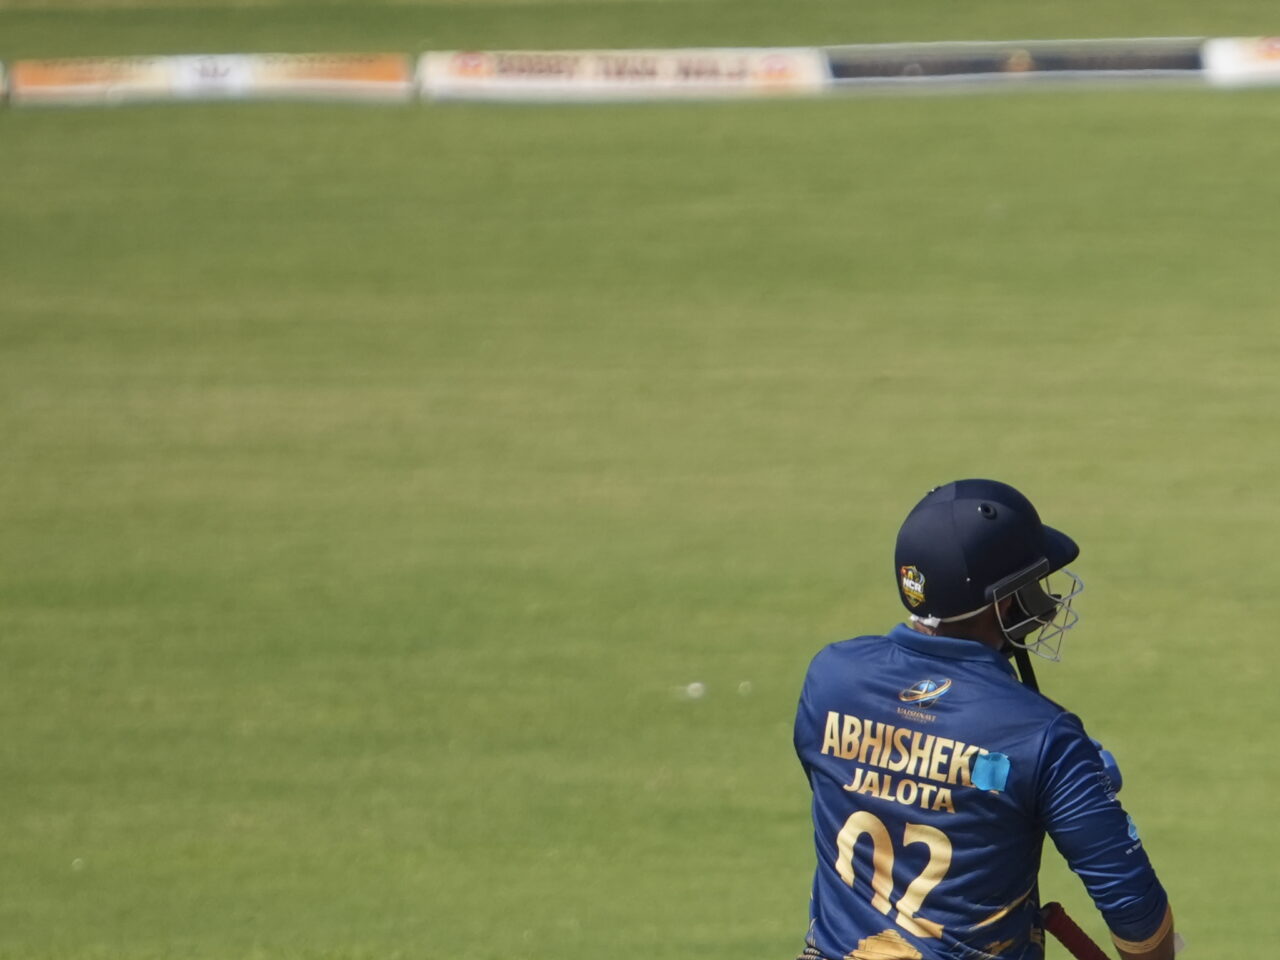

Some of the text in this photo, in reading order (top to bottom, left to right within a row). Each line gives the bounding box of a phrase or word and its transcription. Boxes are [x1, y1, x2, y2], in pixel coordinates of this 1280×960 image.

[903, 576, 924, 593] NCR
[820, 711, 998, 795] ABHISHEK
[843, 768, 956, 814] JALOTA
[835, 810, 953, 939] 02
